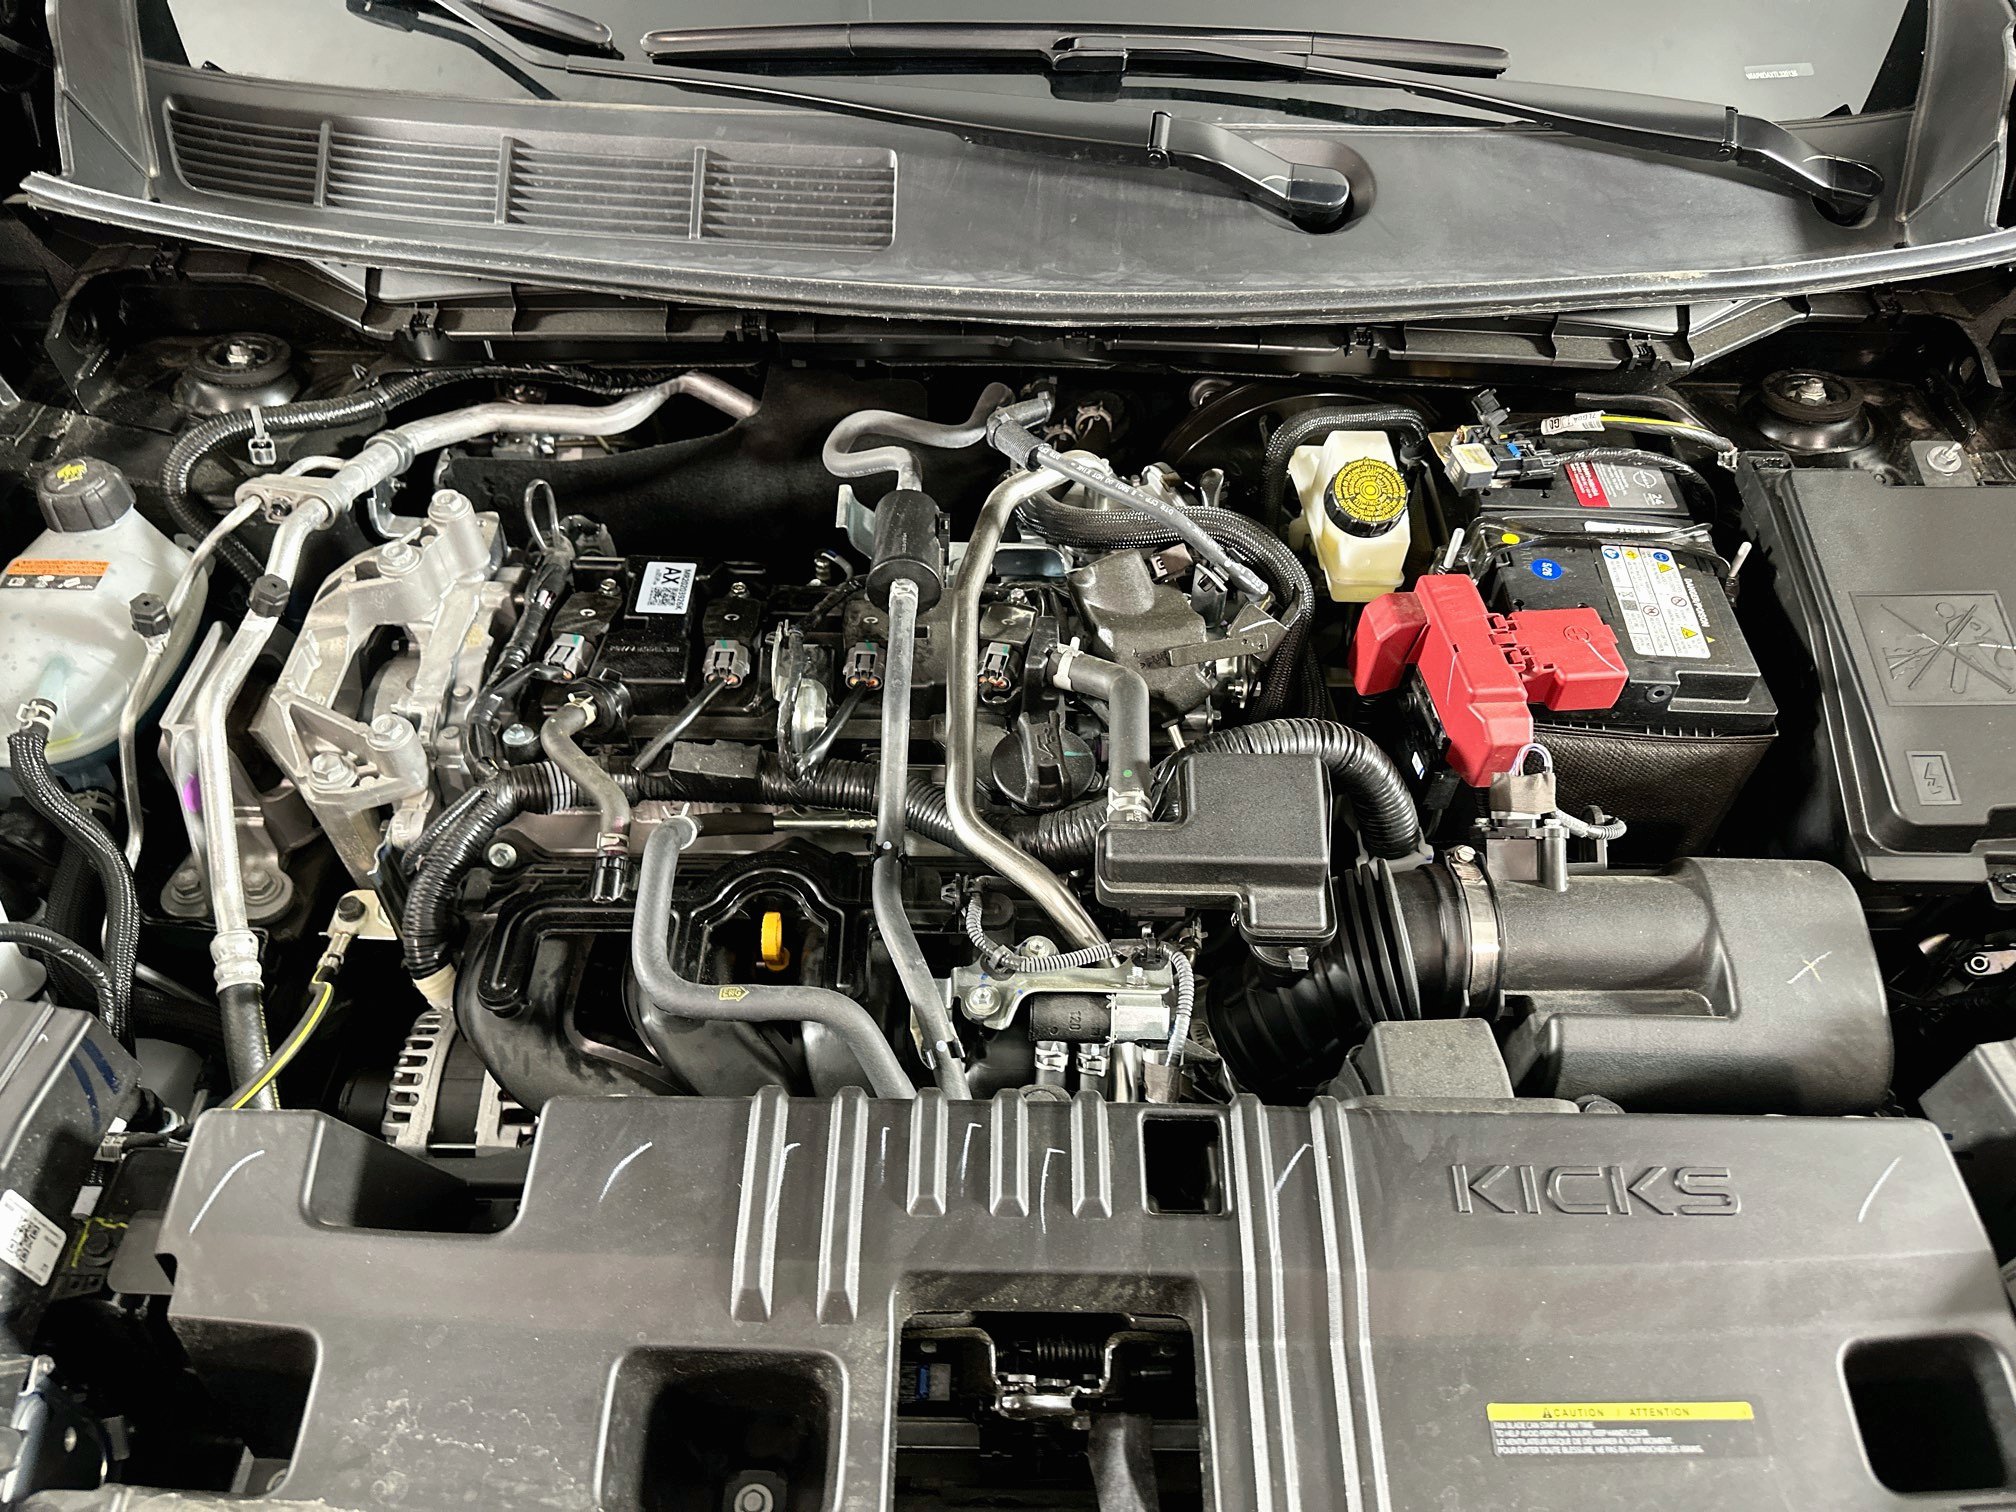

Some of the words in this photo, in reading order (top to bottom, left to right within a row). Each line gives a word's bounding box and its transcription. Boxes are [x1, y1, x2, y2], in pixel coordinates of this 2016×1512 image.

[1158, 503, 1174, 515] DTR
[661, 566, 682, 585] AX
[721, 989, 742, 998] ENG
[1452, 1164, 1742, 1216] KICKS
[1554, 1408, 1604, 1417] CAUTION
[1630, 1408, 1690, 1417] ATTENTION
